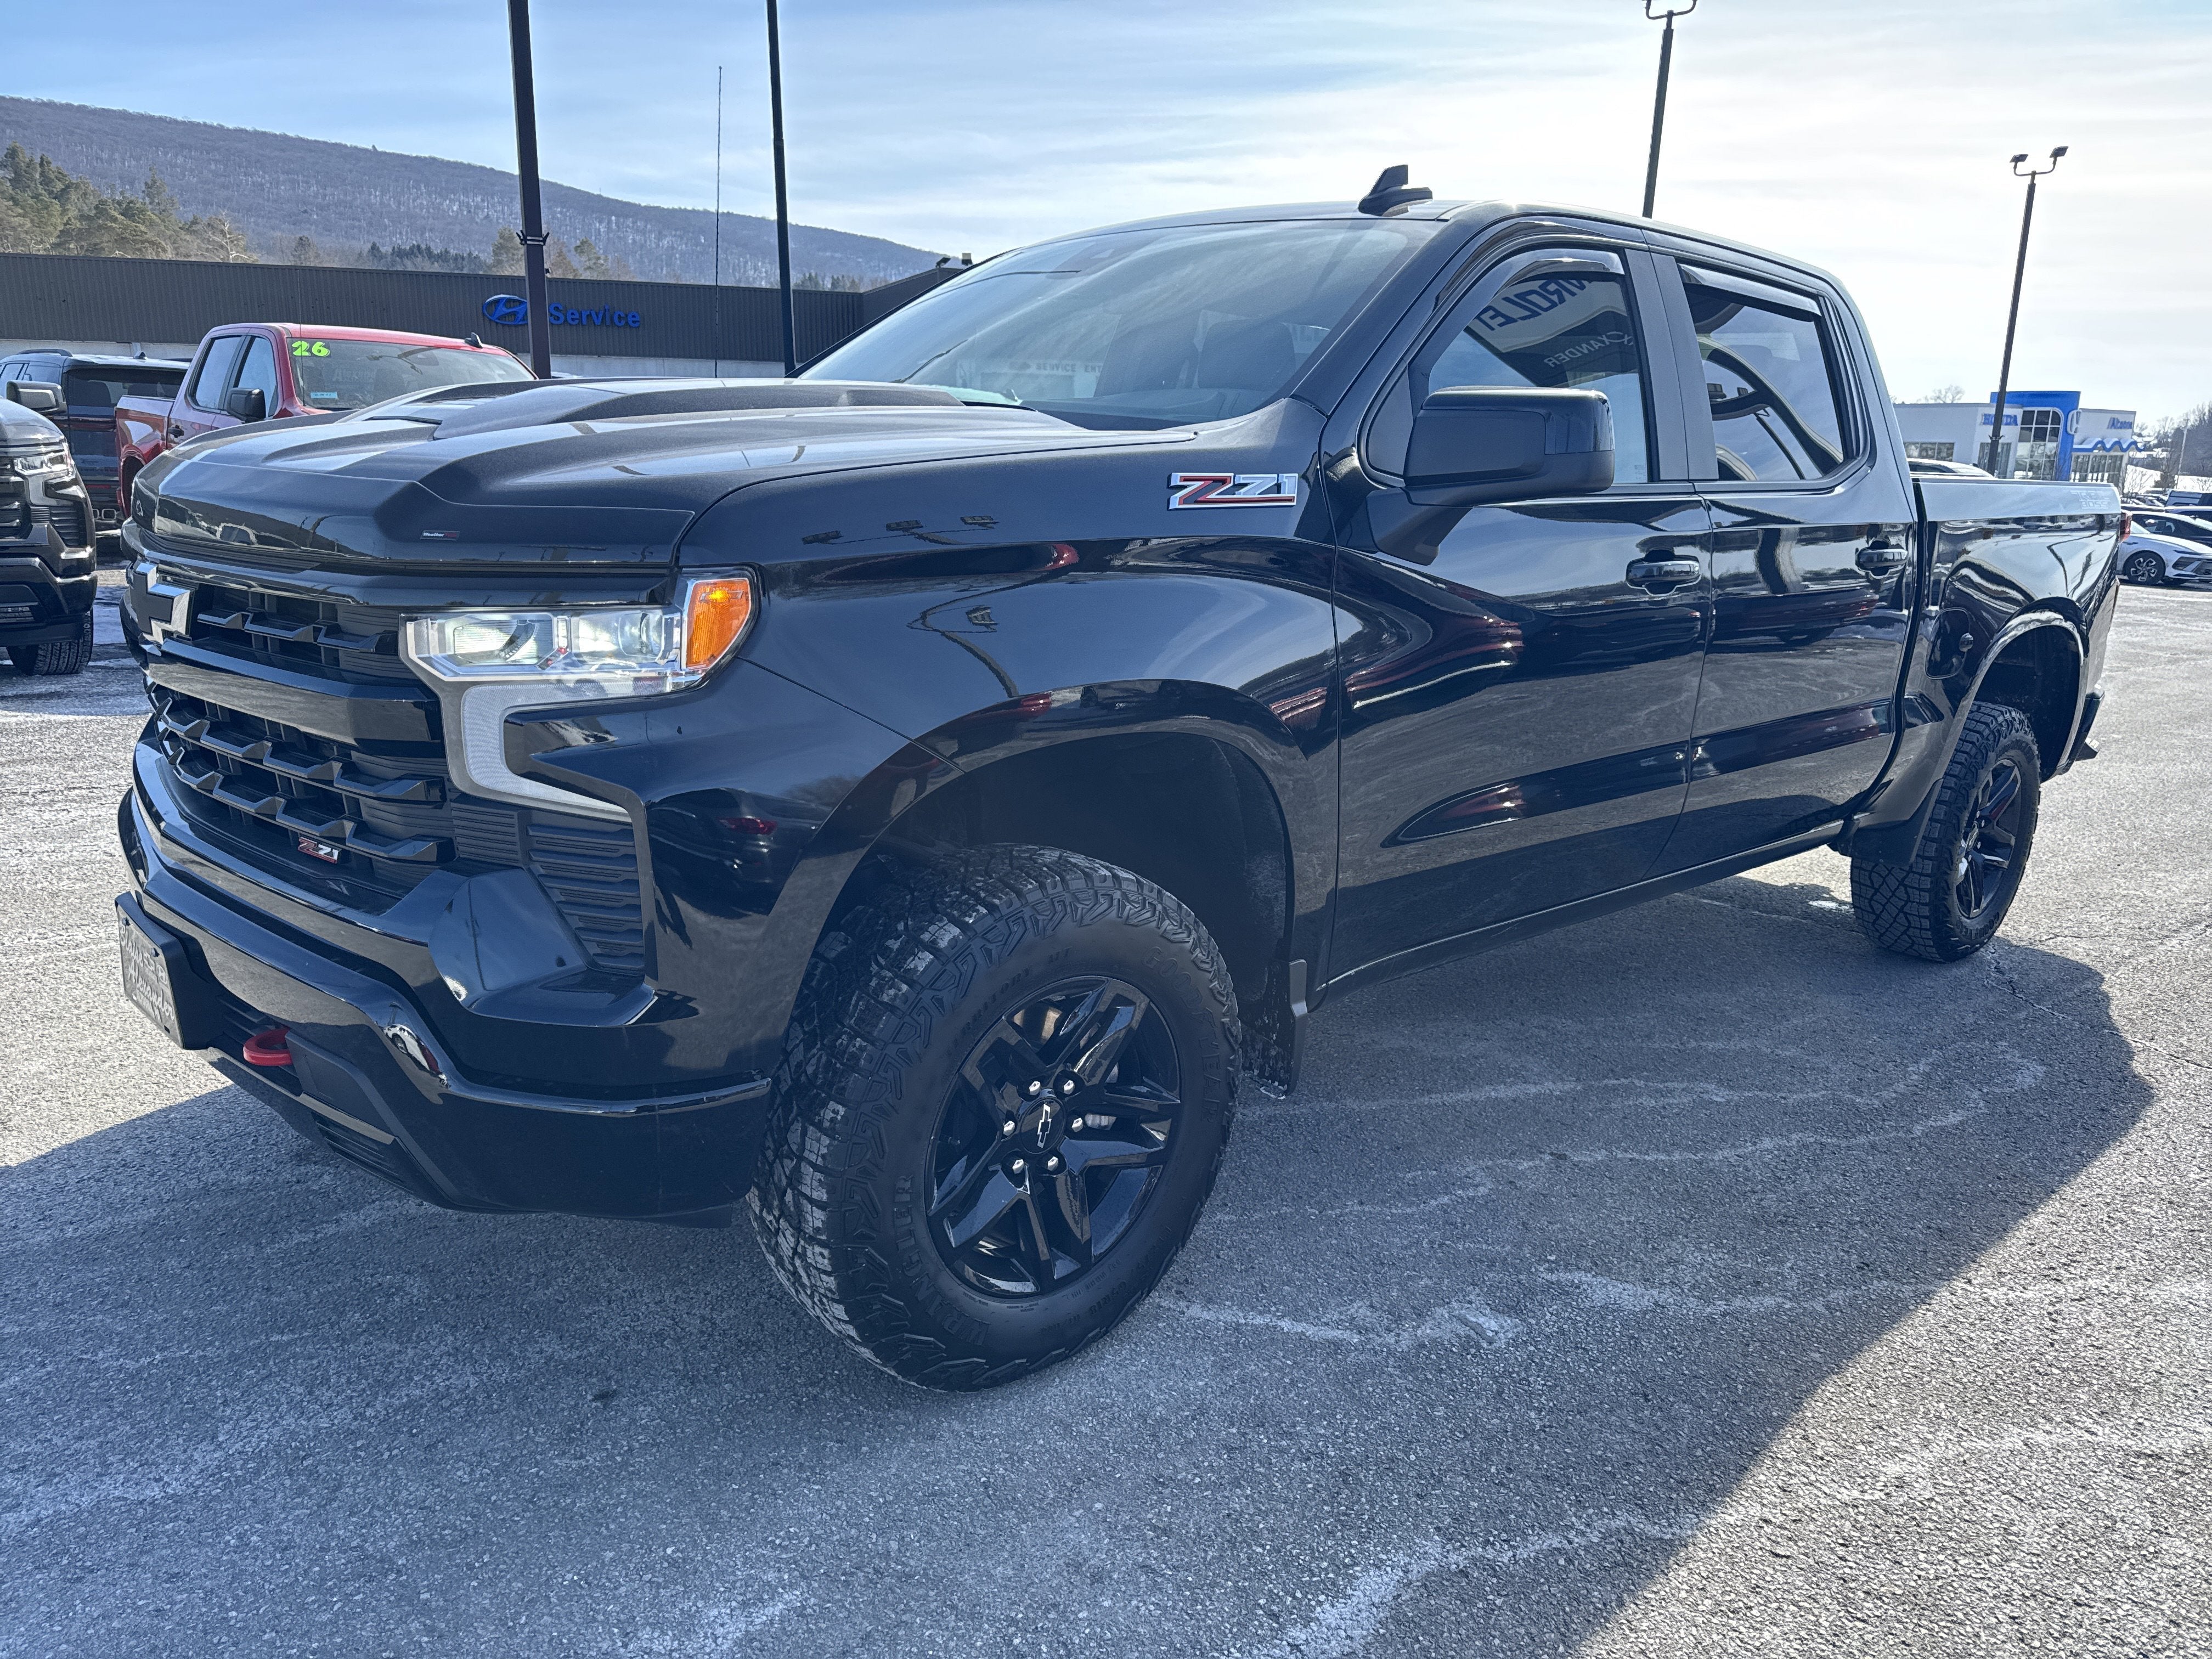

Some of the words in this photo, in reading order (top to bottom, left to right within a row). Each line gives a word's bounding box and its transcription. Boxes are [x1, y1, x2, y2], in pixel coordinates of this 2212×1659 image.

[549, 302, 641, 328] Service
[292, 341, 330, 357] 26
[1982, 413, 2018, 426] HODA
[1167, 472, 1298, 510] Z71
[298, 837, 339, 864] Z71
[1141, 945, 1222, 1124] GOODYEAR
[892, 1172, 991, 1347] WRANGLER
